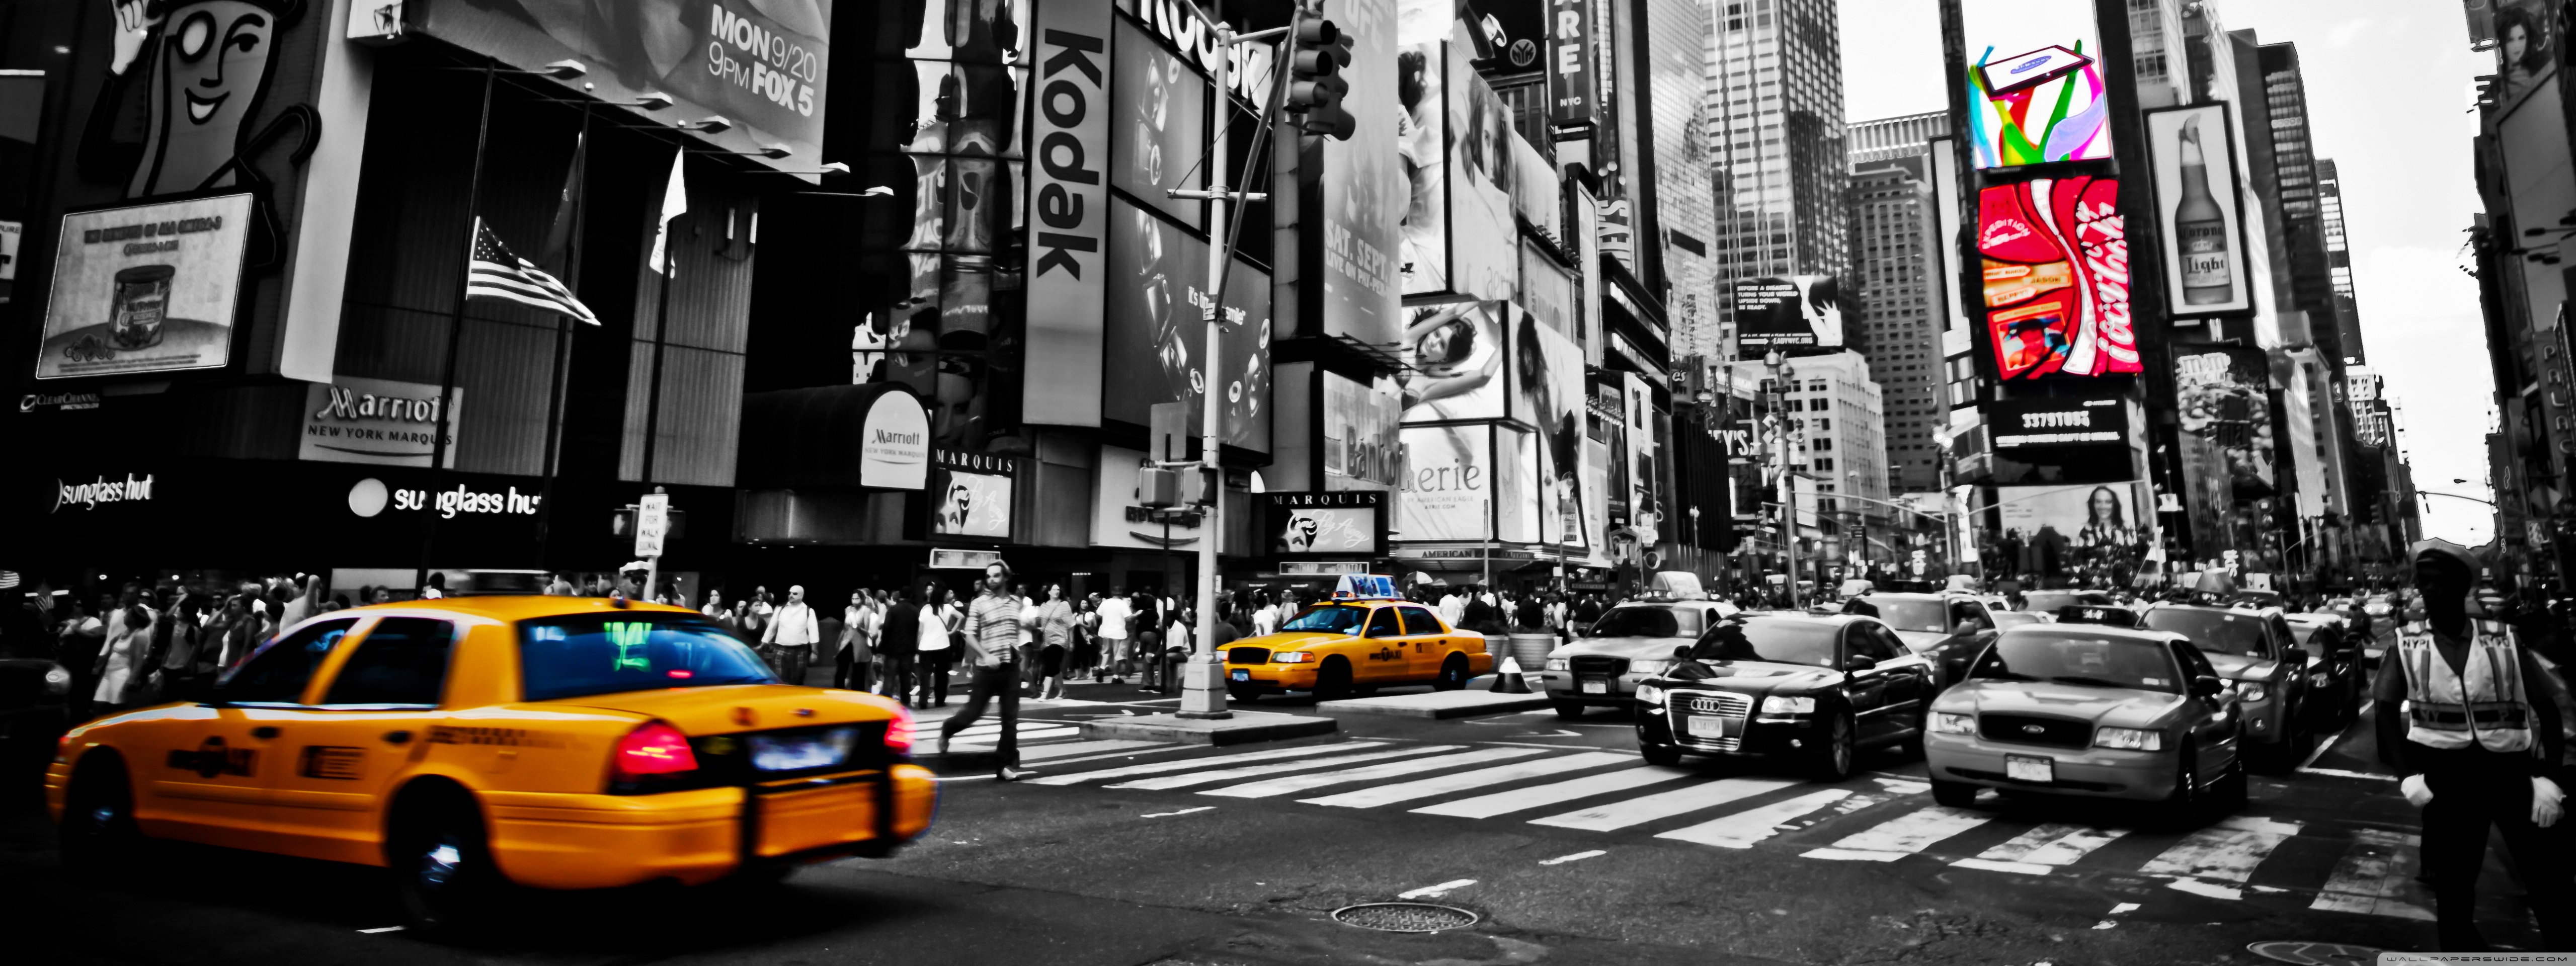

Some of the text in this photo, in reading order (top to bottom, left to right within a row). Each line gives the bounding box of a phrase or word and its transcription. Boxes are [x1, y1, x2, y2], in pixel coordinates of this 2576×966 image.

[711, 4, 817, 83] MON 9/20
[708, 42, 814, 117] 9PM FOX 5
[1560, 97, 1581, 107] NYC
[1036, 29, 1103, 282] Kodak
[1326, 218, 1353, 261] SAT.
[308, 425, 452, 445] NEW YORK MARQUS
[871, 429, 920, 445] Marriott
[936, 449, 1012, 472] MARQUIS
[62, 472, 153, 510] sunglass hut
[1274, 494, 1376, 506] MARQUIS
[1422, 550, 1472, 558] AMERICAN
